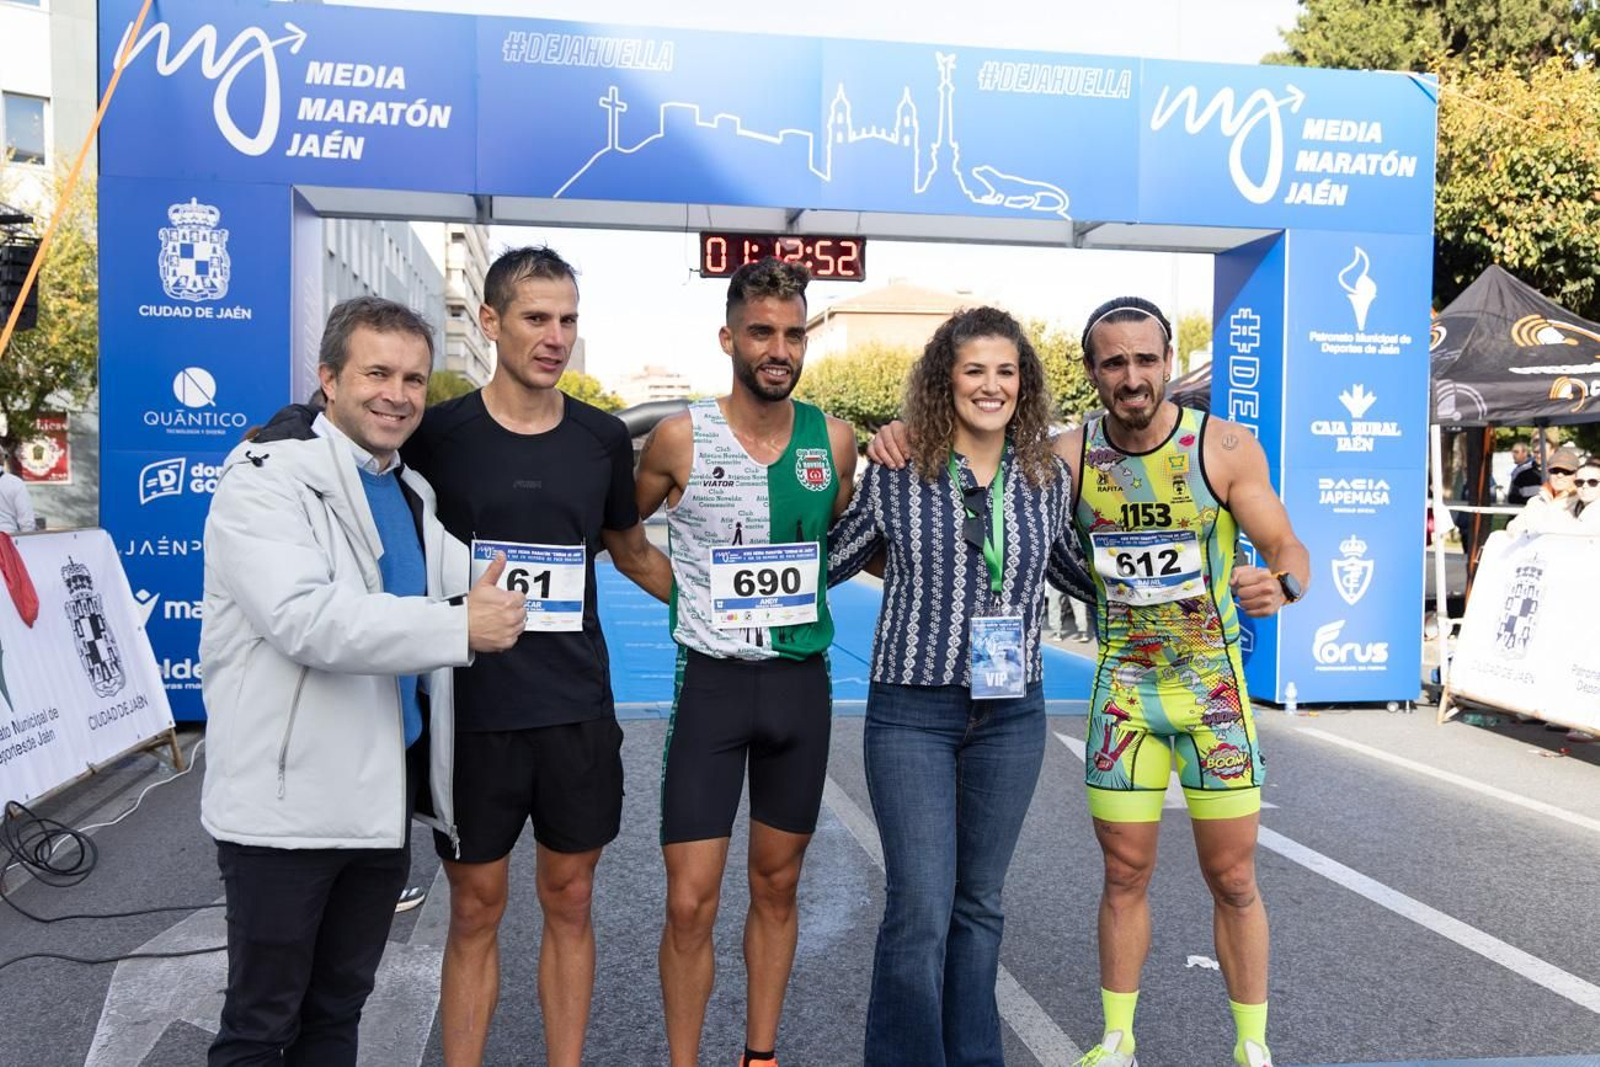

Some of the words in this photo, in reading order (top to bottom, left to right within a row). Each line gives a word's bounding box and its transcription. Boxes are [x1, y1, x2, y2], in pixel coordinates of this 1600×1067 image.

[502, 31, 674, 72] #DEJAHUELLA
[305, 60, 406, 90] MEDIA
[978, 61, 1132, 99] #DEJAHUELLA
[297, 97, 452, 129] MARATÓN
[1303, 118, 1382, 144] MEDIA
[286, 130, 365, 161] JAÉN
[1295, 149, 1416, 178] MARATÓN
[1283, 180, 1348, 207] JAÉN
[138, 304, 193, 318] CIUDAD
[195, 306, 214, 319] DE
[216, 305, 252, 320] JAÉN
[1310, 421, 1347, 436] CAJA
[1351, 421, 1402, 437] RURAL
[1336, 436, 1374, 453] JAÉN
[1319, 478, 1390, 490] DACIA
[1319, 491, 1390, 505] JAPEMASA
[1120, 502, 1172, 528] 1153
[1116, 549, 1182, 577] 612
[506, 568, 551, 599] 61
[733, 567, 801, 597] 690
[985, 672, 1007, 687] VIP
[1206, 752, 1249, 769] BOOM!
